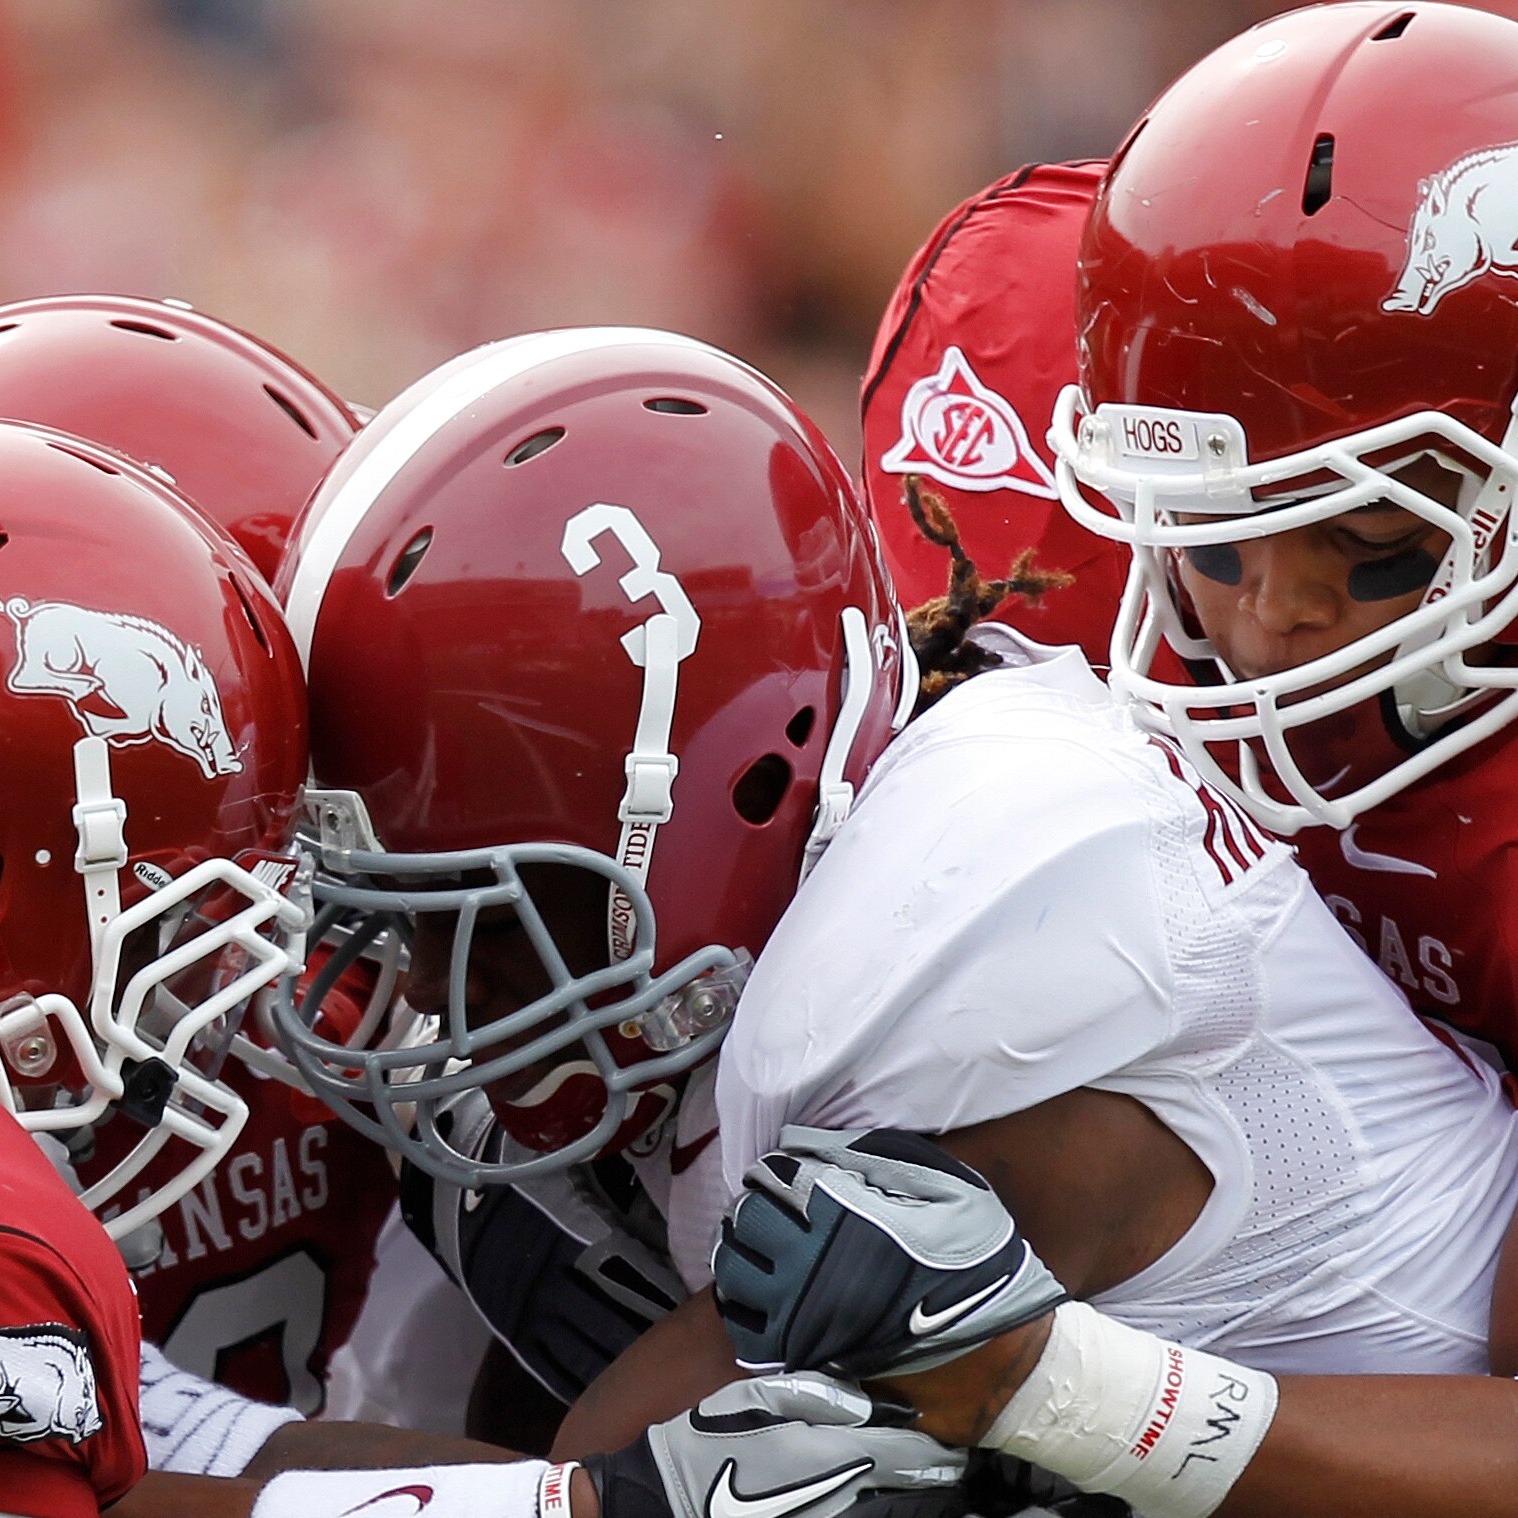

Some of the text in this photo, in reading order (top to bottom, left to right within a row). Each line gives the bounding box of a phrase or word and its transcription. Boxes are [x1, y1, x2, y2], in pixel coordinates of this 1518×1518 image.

[934, 402, 995, 468] SEC
[1122, 416, 1183, 454] HOGS
[560, 502, 701, 668] 3
[134, 862, 174, 890] Ridde
[1130, 1347, 1184, 1462] SHOWTIME
[543, 1463, 564, 1512] TIME
